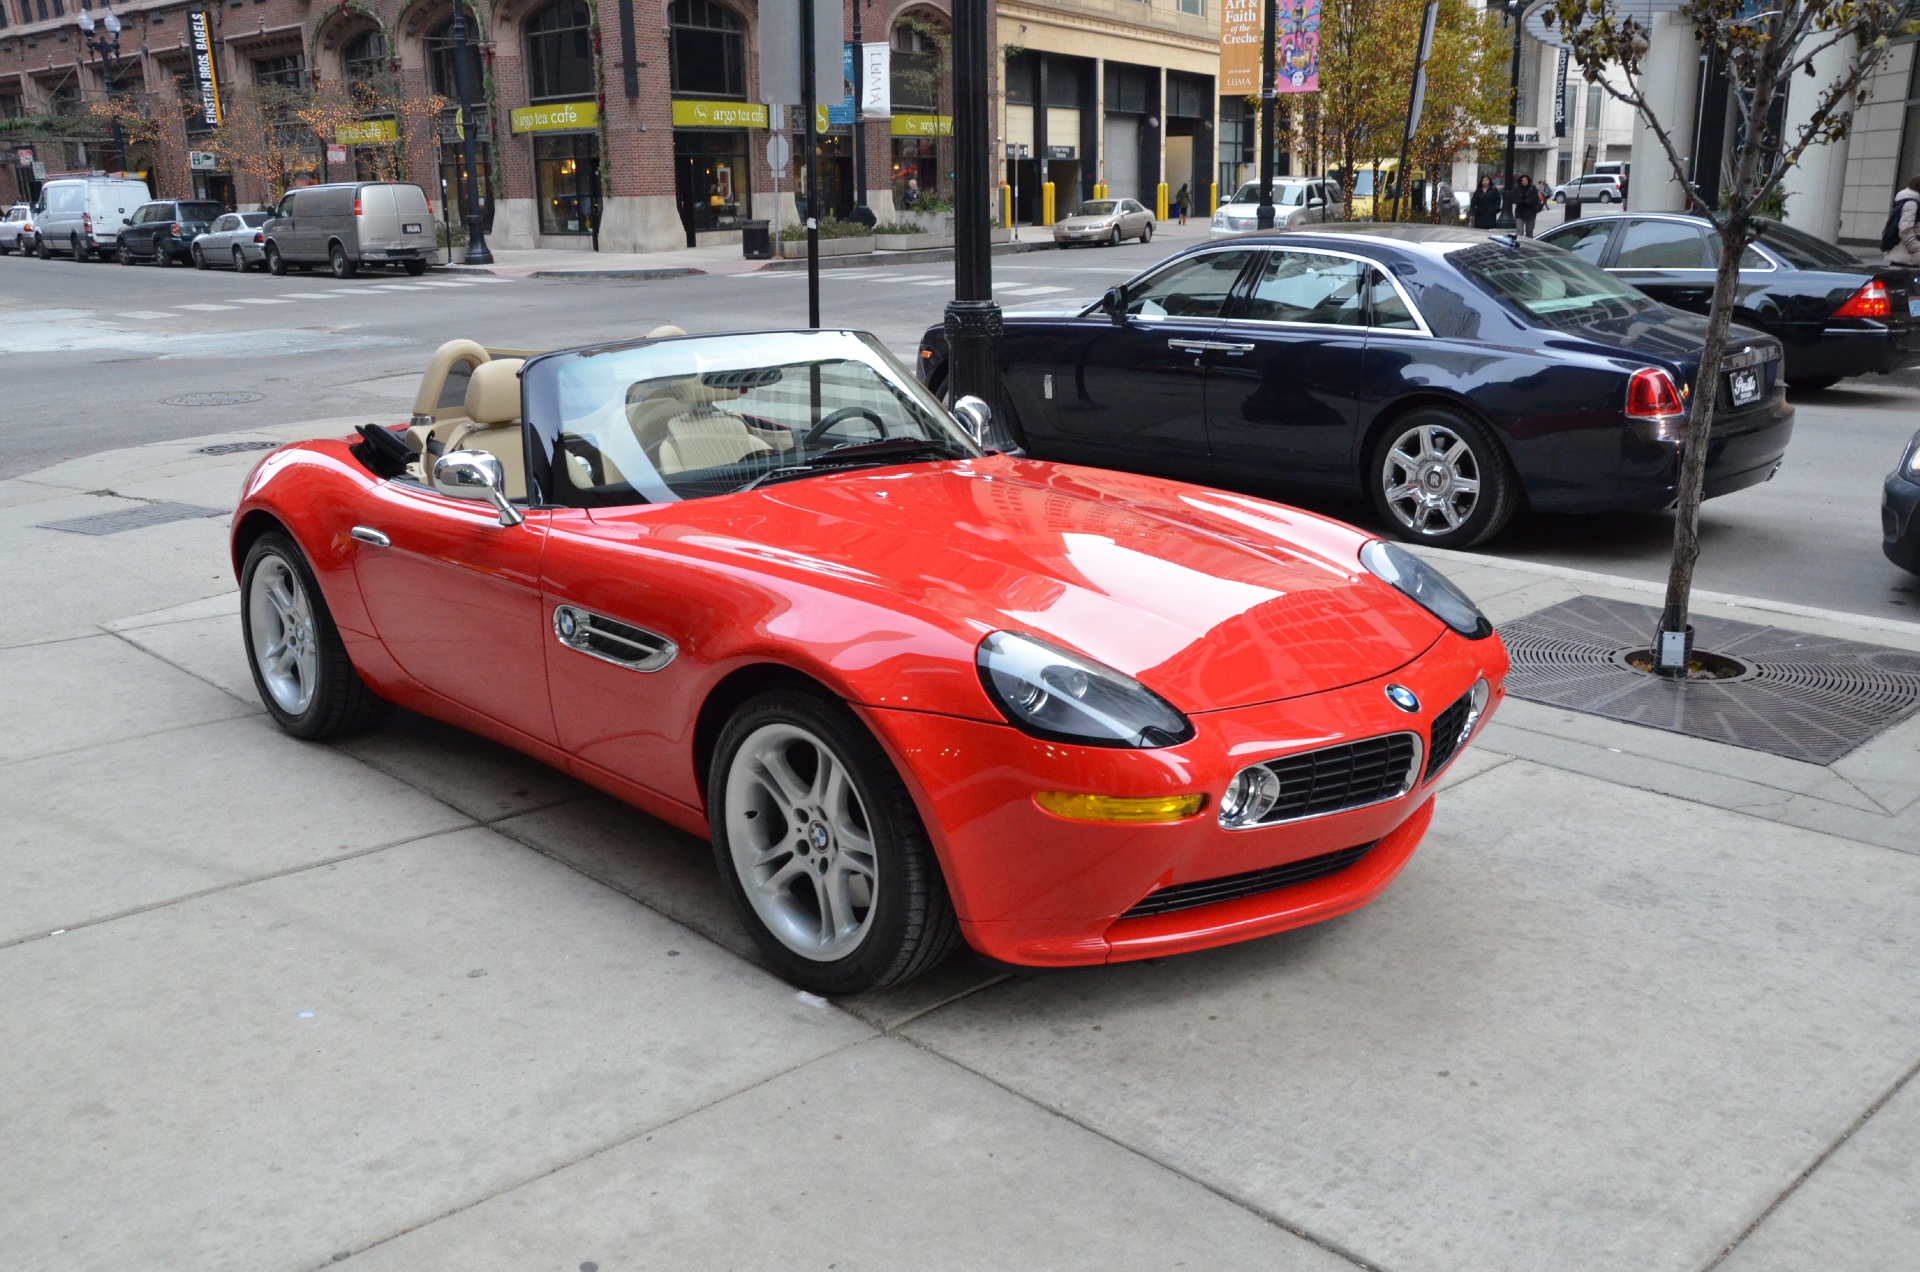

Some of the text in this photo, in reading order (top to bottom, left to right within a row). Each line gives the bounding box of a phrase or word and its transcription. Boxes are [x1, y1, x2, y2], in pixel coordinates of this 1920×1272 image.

[1225, 0, 1258, 9] Art &
[1225, 9, 1257, 23] Faith
[1230, 23, 1250, 34] of the
[1222, 33, 1258, 44] Creche
[191, 13, 217, 124] EINSTEIN BROS. BAGELS
[1227, 78, 1251, 86] LUMA
[1555, 48, 1567, 123] RDSTROM rack
[520, 105, 577, 130] argo tea café
[713, 109, 736, 125] argo
[738, 108, 750, 122] tea
